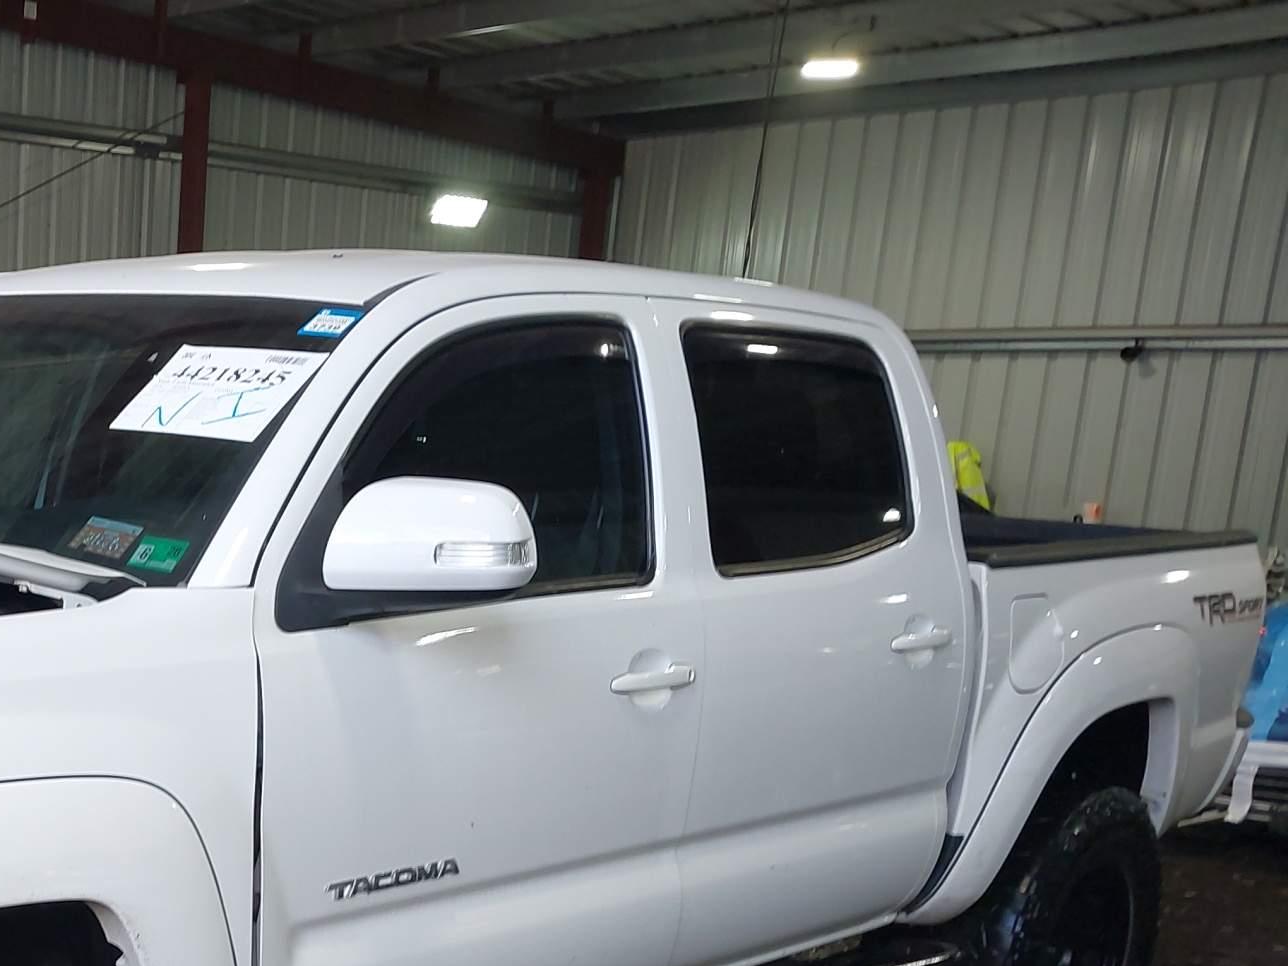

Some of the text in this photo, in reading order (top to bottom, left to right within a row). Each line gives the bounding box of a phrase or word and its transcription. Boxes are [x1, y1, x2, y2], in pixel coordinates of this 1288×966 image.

[172, 364, 292, 388] 44218245
[1193, 592, 1237, 626] TRD
[325, 858, 460, 900] TACOMA
